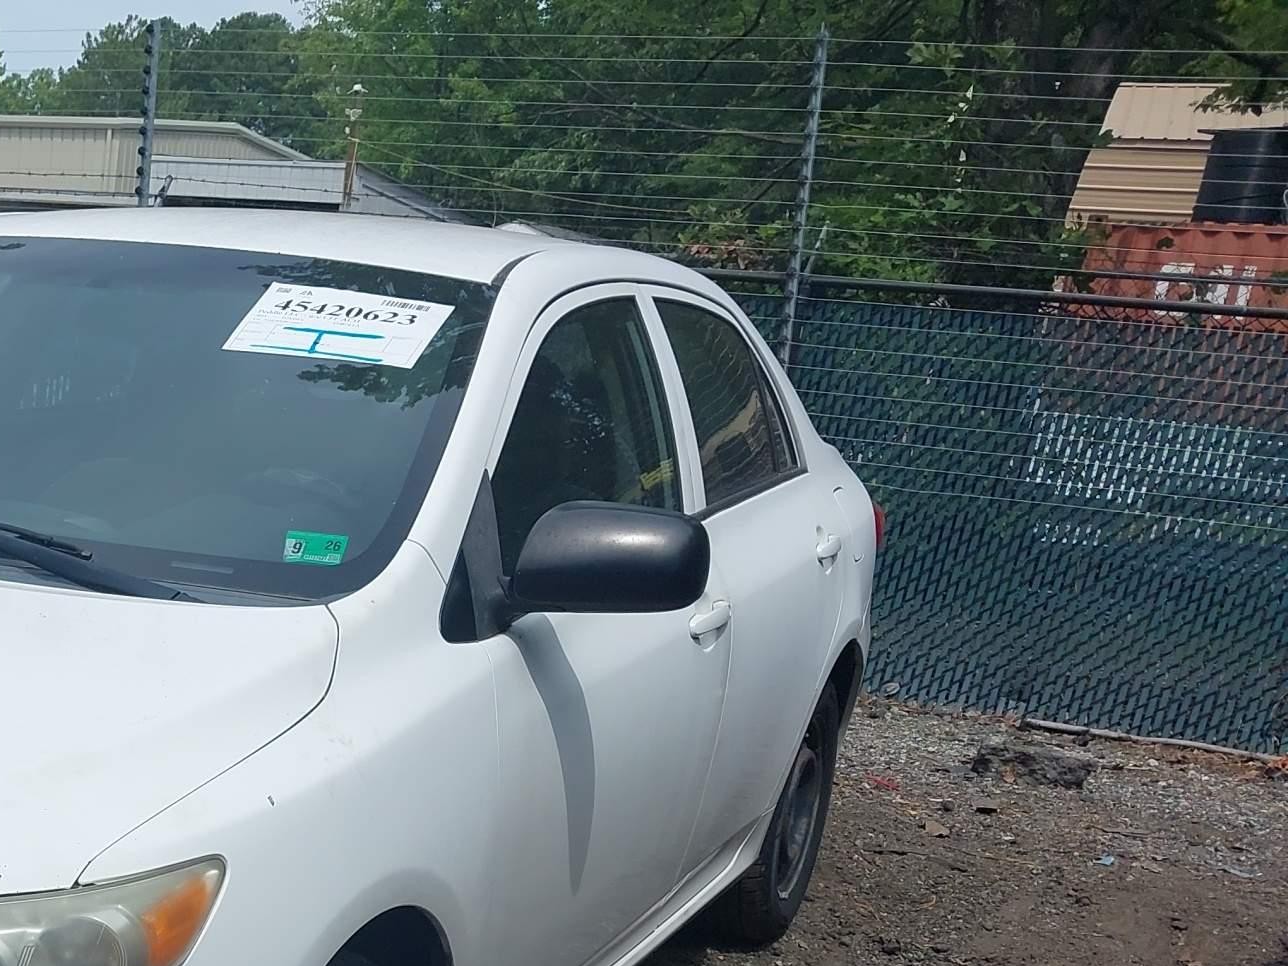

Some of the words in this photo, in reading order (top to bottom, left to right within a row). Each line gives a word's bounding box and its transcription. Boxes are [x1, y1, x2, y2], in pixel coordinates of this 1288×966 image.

[274, 299, 418, 325] 45420623
[291, 542, 303, 554] 9
[324, 540, 342, 552] 26
